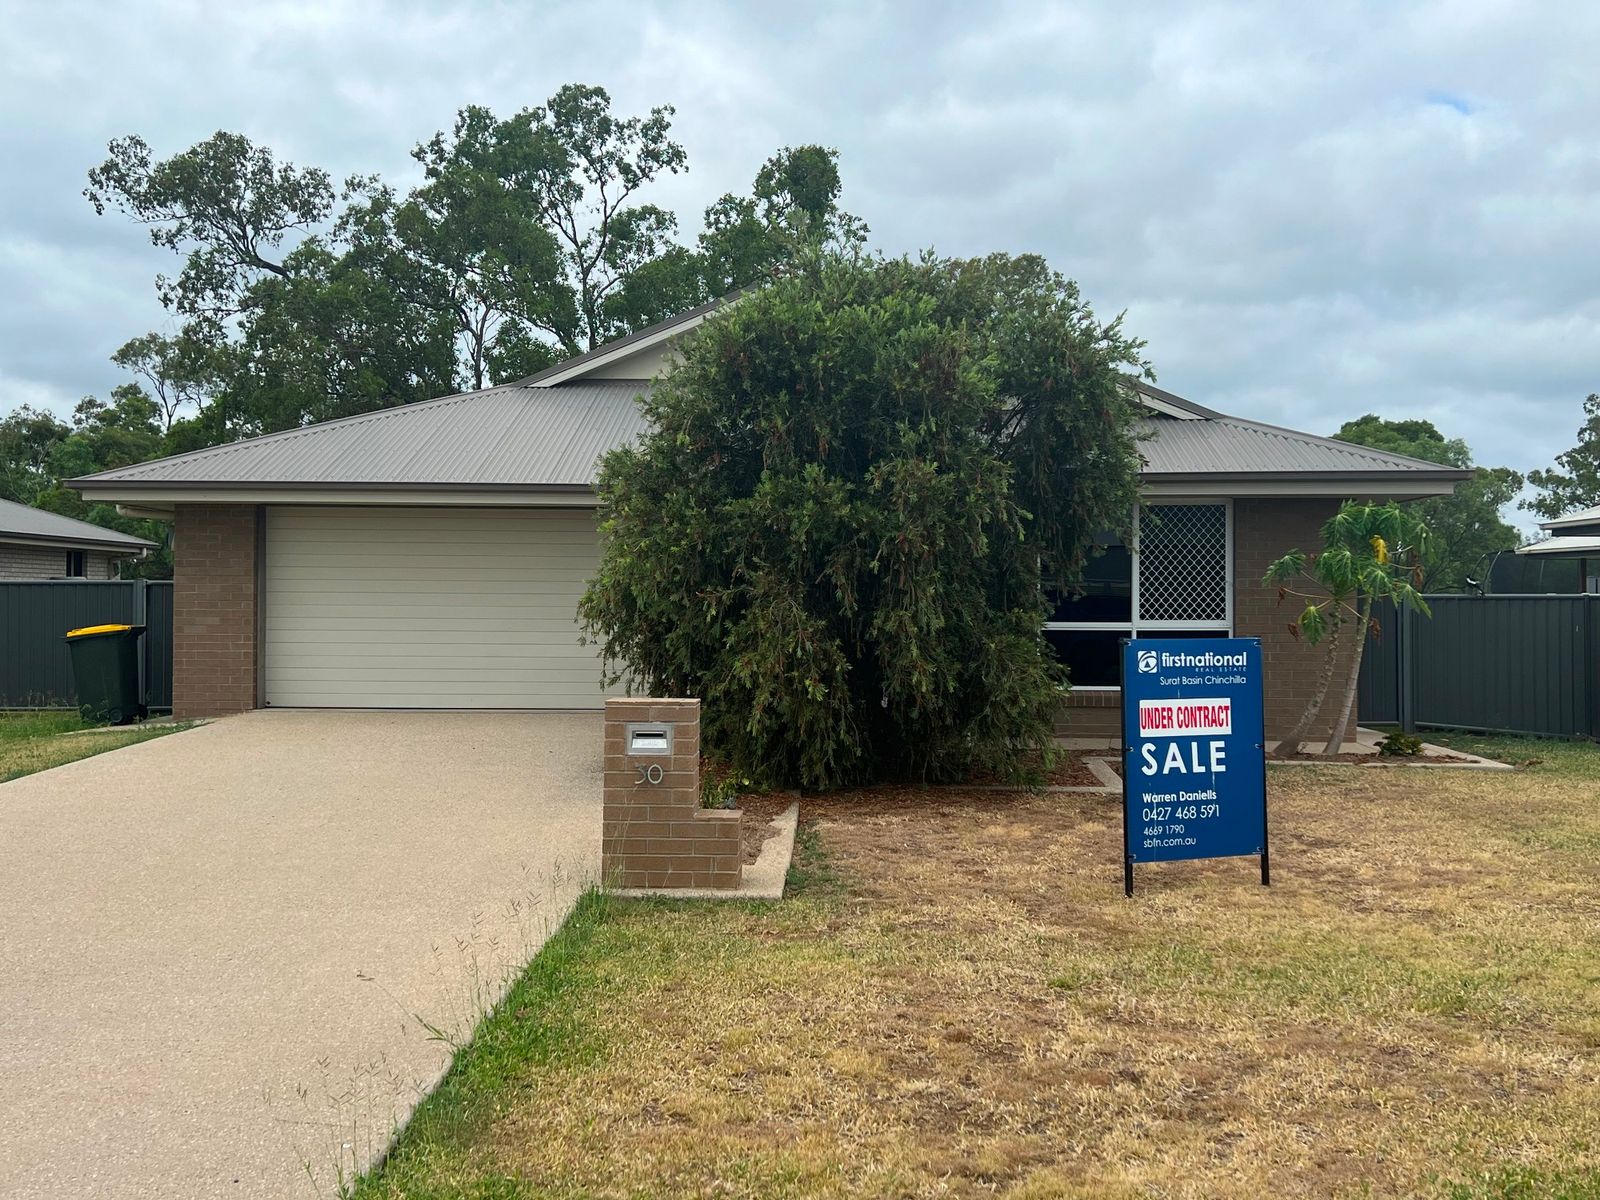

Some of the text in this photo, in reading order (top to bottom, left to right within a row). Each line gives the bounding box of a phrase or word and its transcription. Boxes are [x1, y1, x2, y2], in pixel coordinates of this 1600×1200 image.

[1161, 652, 1247, 667] firstnational
[1160, 675, 1246, 685] Surat Basin Chinchilla
[1140, 705, 1230, 730] UNDER CONTRACT
[1141, 741, 1226, 776] SALE
[1142, 790, 1217, 803] Warren Daniells
[1142, 804, 1220, 821] 0427 468 591
[1143, 824, 1185, 836] 4669 1790
[1143, 837, 1197, 848] sbfn.com.au
